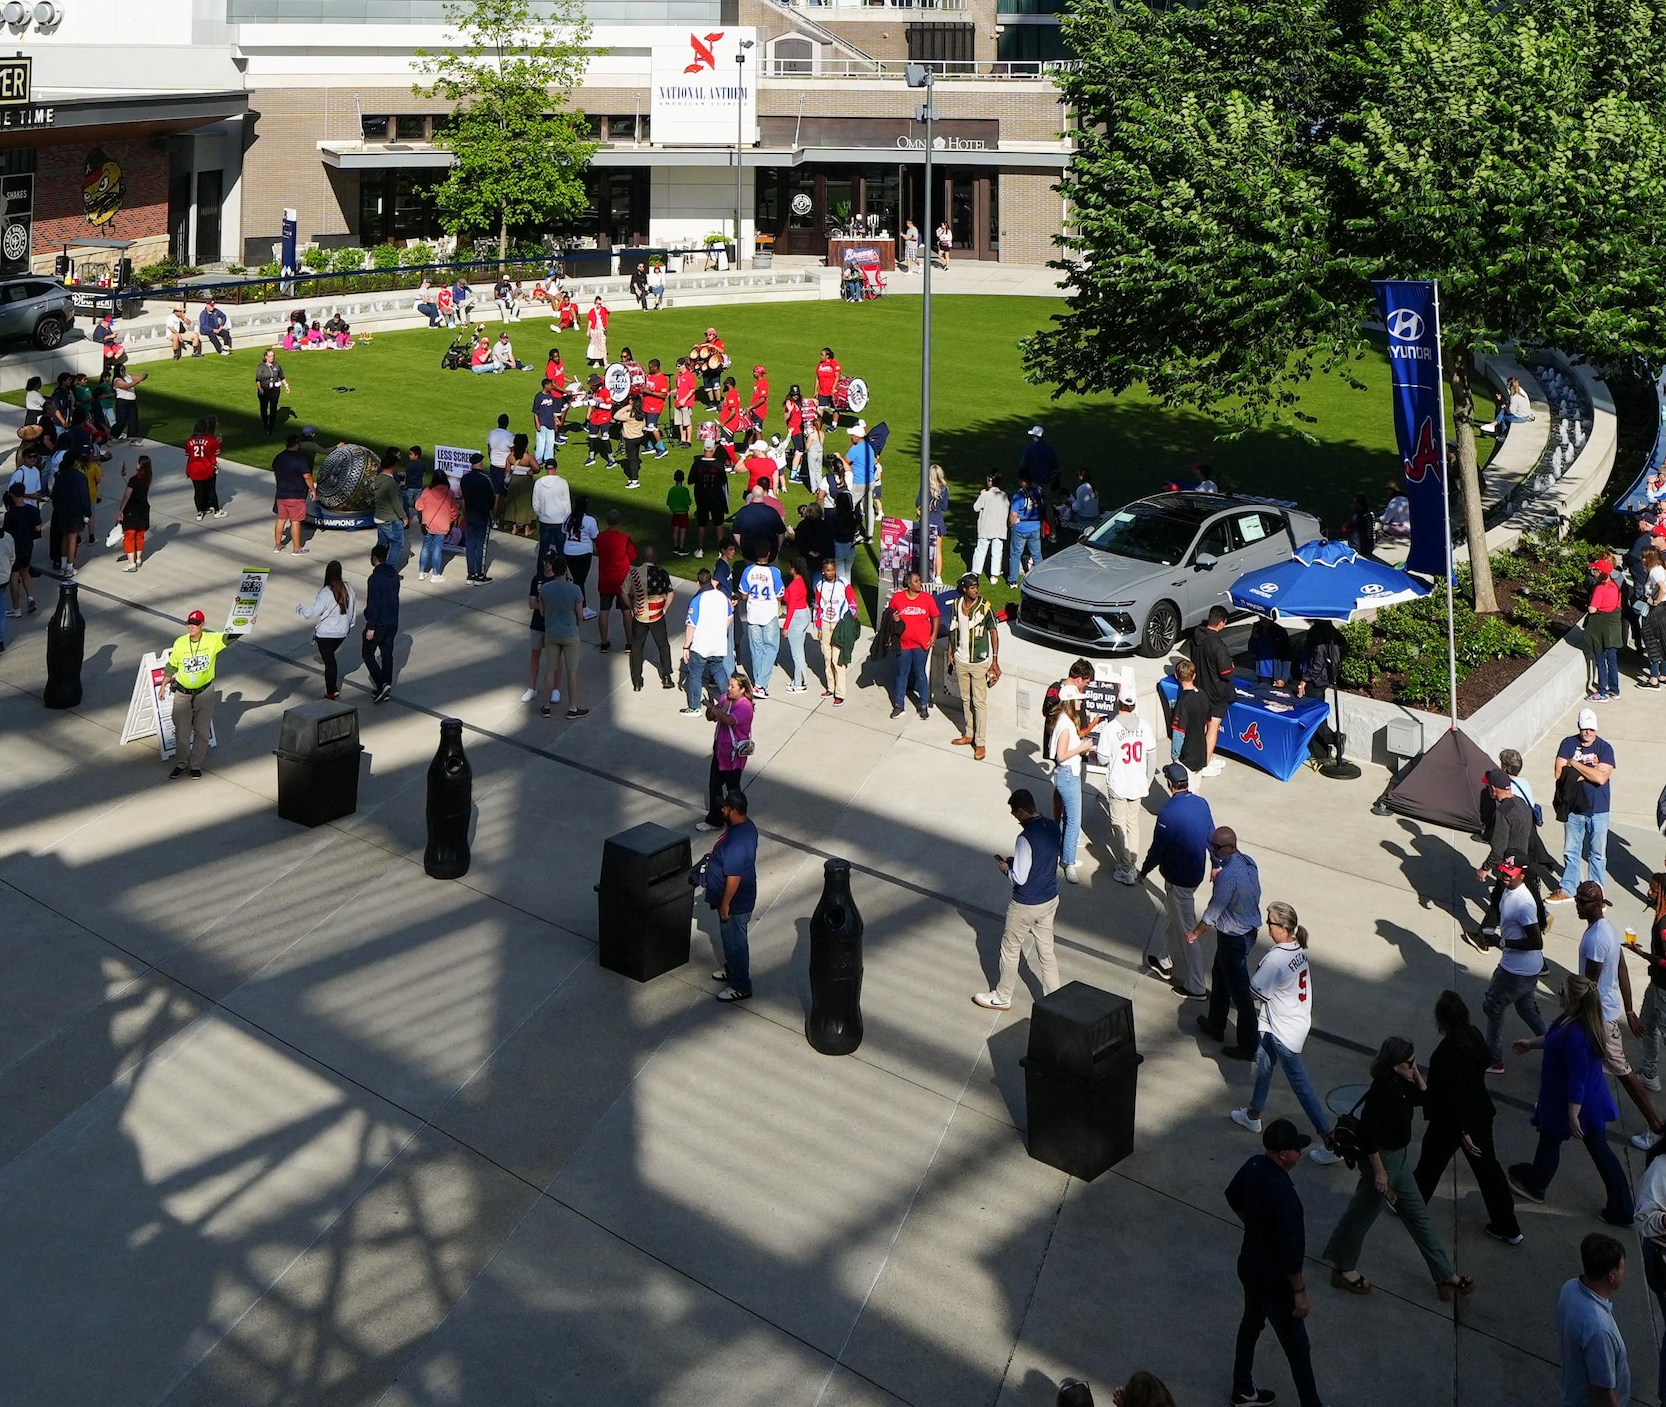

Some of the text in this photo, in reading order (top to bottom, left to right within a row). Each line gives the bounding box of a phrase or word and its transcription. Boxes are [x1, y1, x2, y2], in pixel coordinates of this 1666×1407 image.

[659, 86, 748, 100] NATIONAL ANTHEM
[19, 109, 55, 125] TIME
[896, 136, 988, 150] OMN HOTEL
[6, 190, 28, 201] SHAKES
[193, 445, 205, 458] 21
[437, 448, 453, 461] LESS
[437, 460, 454, 472] TIME
[750, 572, 769, 584] AARON
[749, 584, 771, 601] 44
[1085, 689, 1116, 705] Sign up
[1086, 700, 1114, 712] to win!
[1120, 741, 1144, 765] 30
[1298, 969, 1308, 1003] 5
